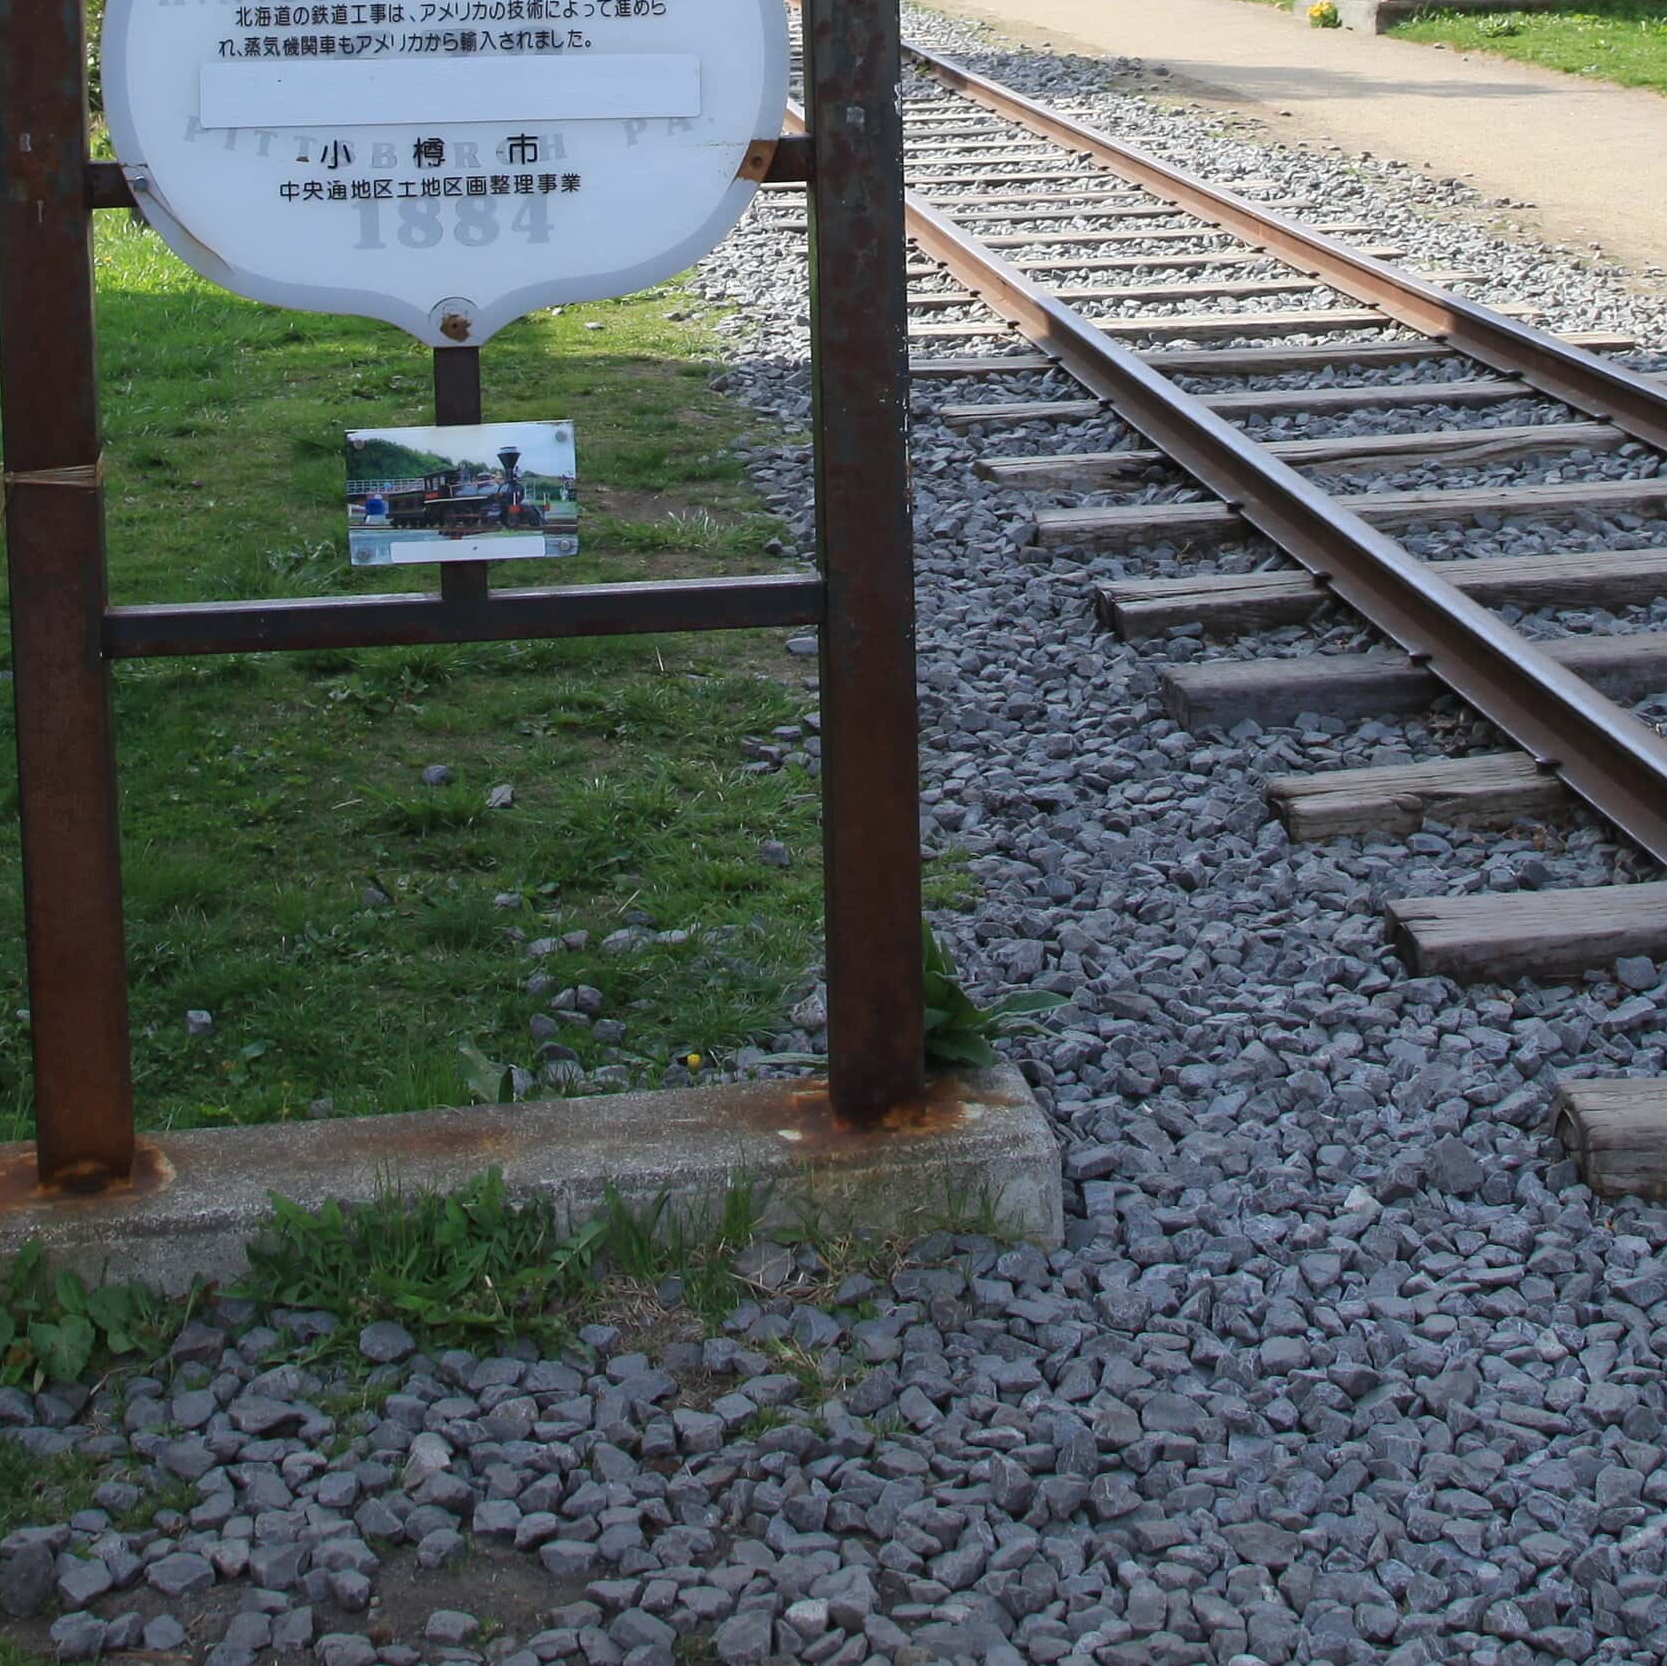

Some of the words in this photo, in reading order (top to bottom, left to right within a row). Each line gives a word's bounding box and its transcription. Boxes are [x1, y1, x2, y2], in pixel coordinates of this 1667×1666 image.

[218, 29, 593, 58] れ、蒸気機関車もアメリカから輸入されました。
[351, 192, 554, 250] 1884
